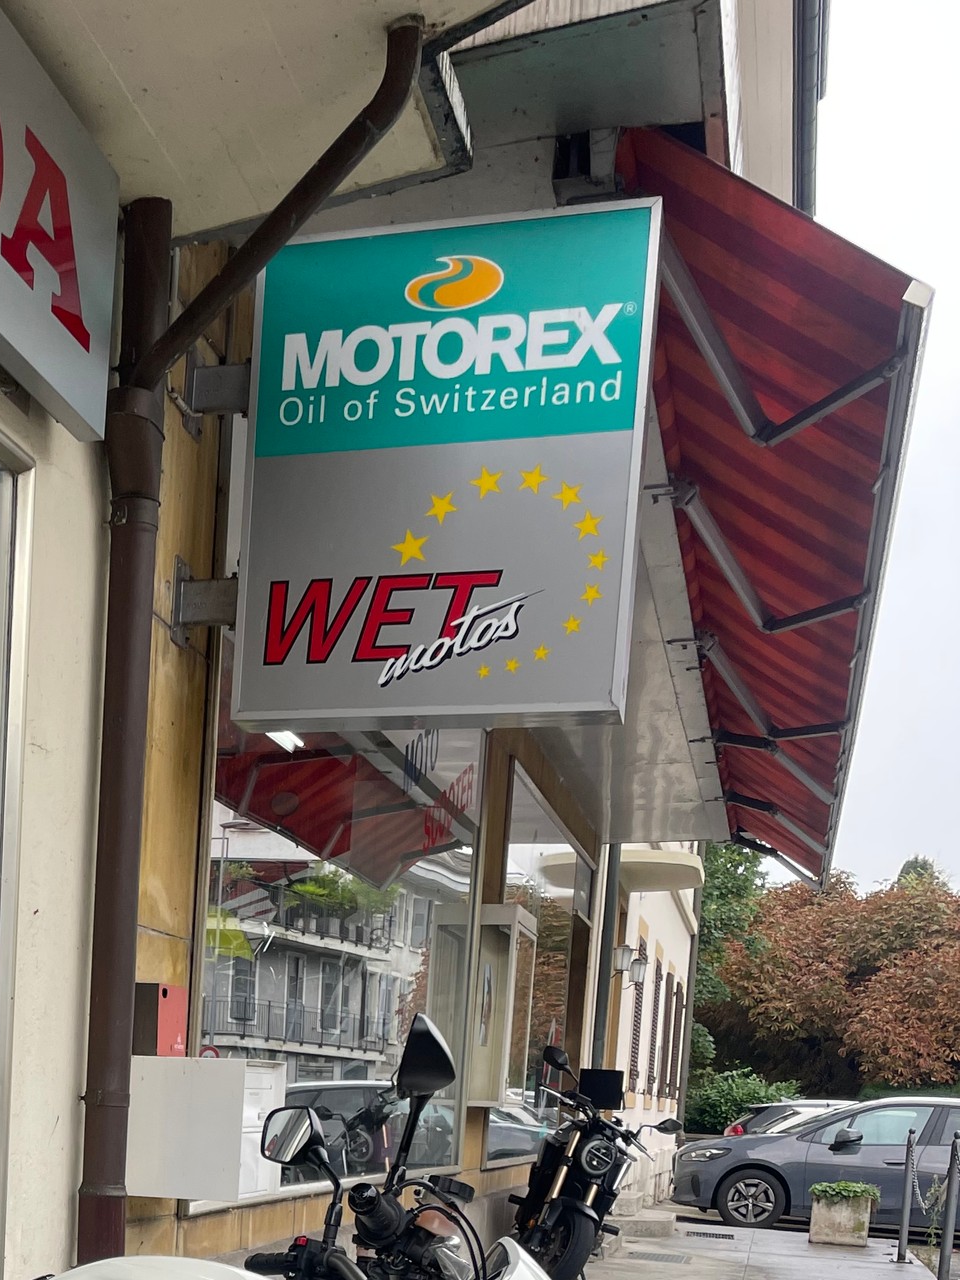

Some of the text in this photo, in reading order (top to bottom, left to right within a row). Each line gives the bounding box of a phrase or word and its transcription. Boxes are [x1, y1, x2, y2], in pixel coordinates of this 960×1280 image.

[282, 303, 624, 391] MOTOREX
[279, 371, 622, 426] Oil of Switzerland
[262, 569, 503, 666] WET
[377, 588, 545, 688] motos
